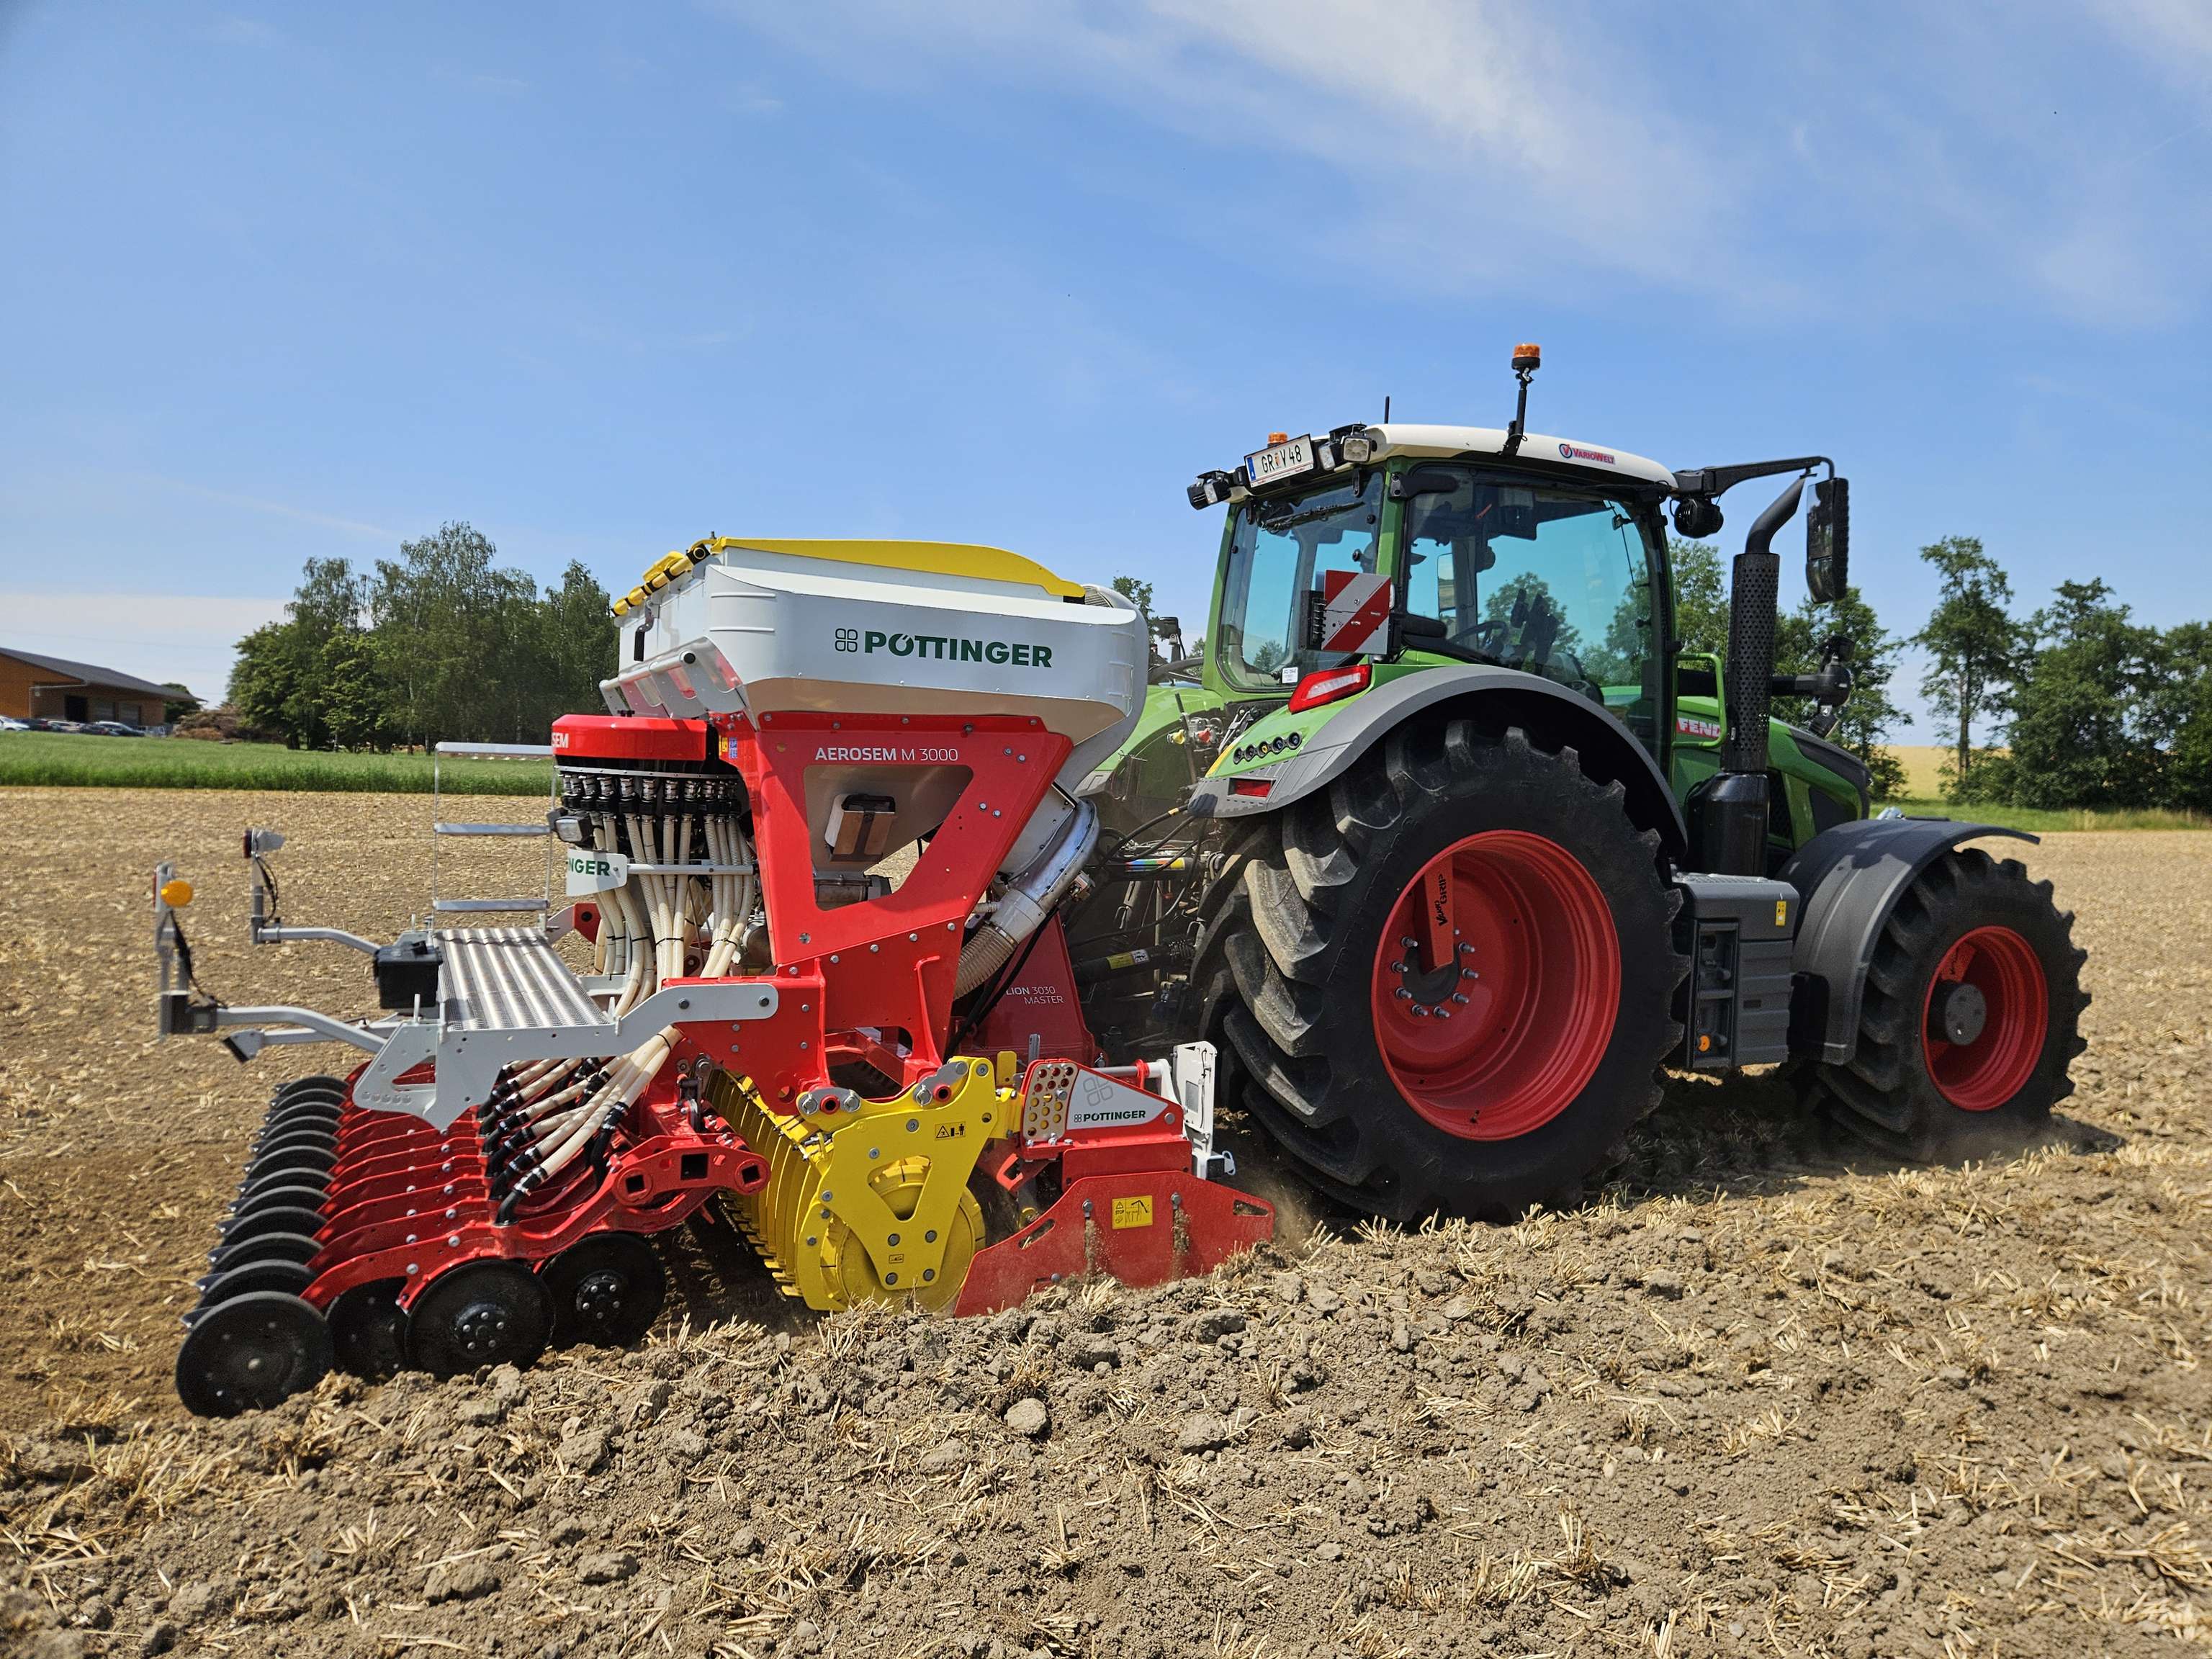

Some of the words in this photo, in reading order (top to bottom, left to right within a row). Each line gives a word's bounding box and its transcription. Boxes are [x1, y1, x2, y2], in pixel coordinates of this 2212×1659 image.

[1261, 454, 1274, 472] GR
[1678, 717, 1721, 737] FEND
[814, 747, 897, 761] AEROSEM
[902, 747, 915, 761] M
[919, 747, 958, 762] 3000
[1438, 873, 1447, 904] GRIP
[1006, 986, 1030, 996] LION
[1031, 985, 1056, 995] 3030
[1023, 994, 1064, 1005] MASTER
